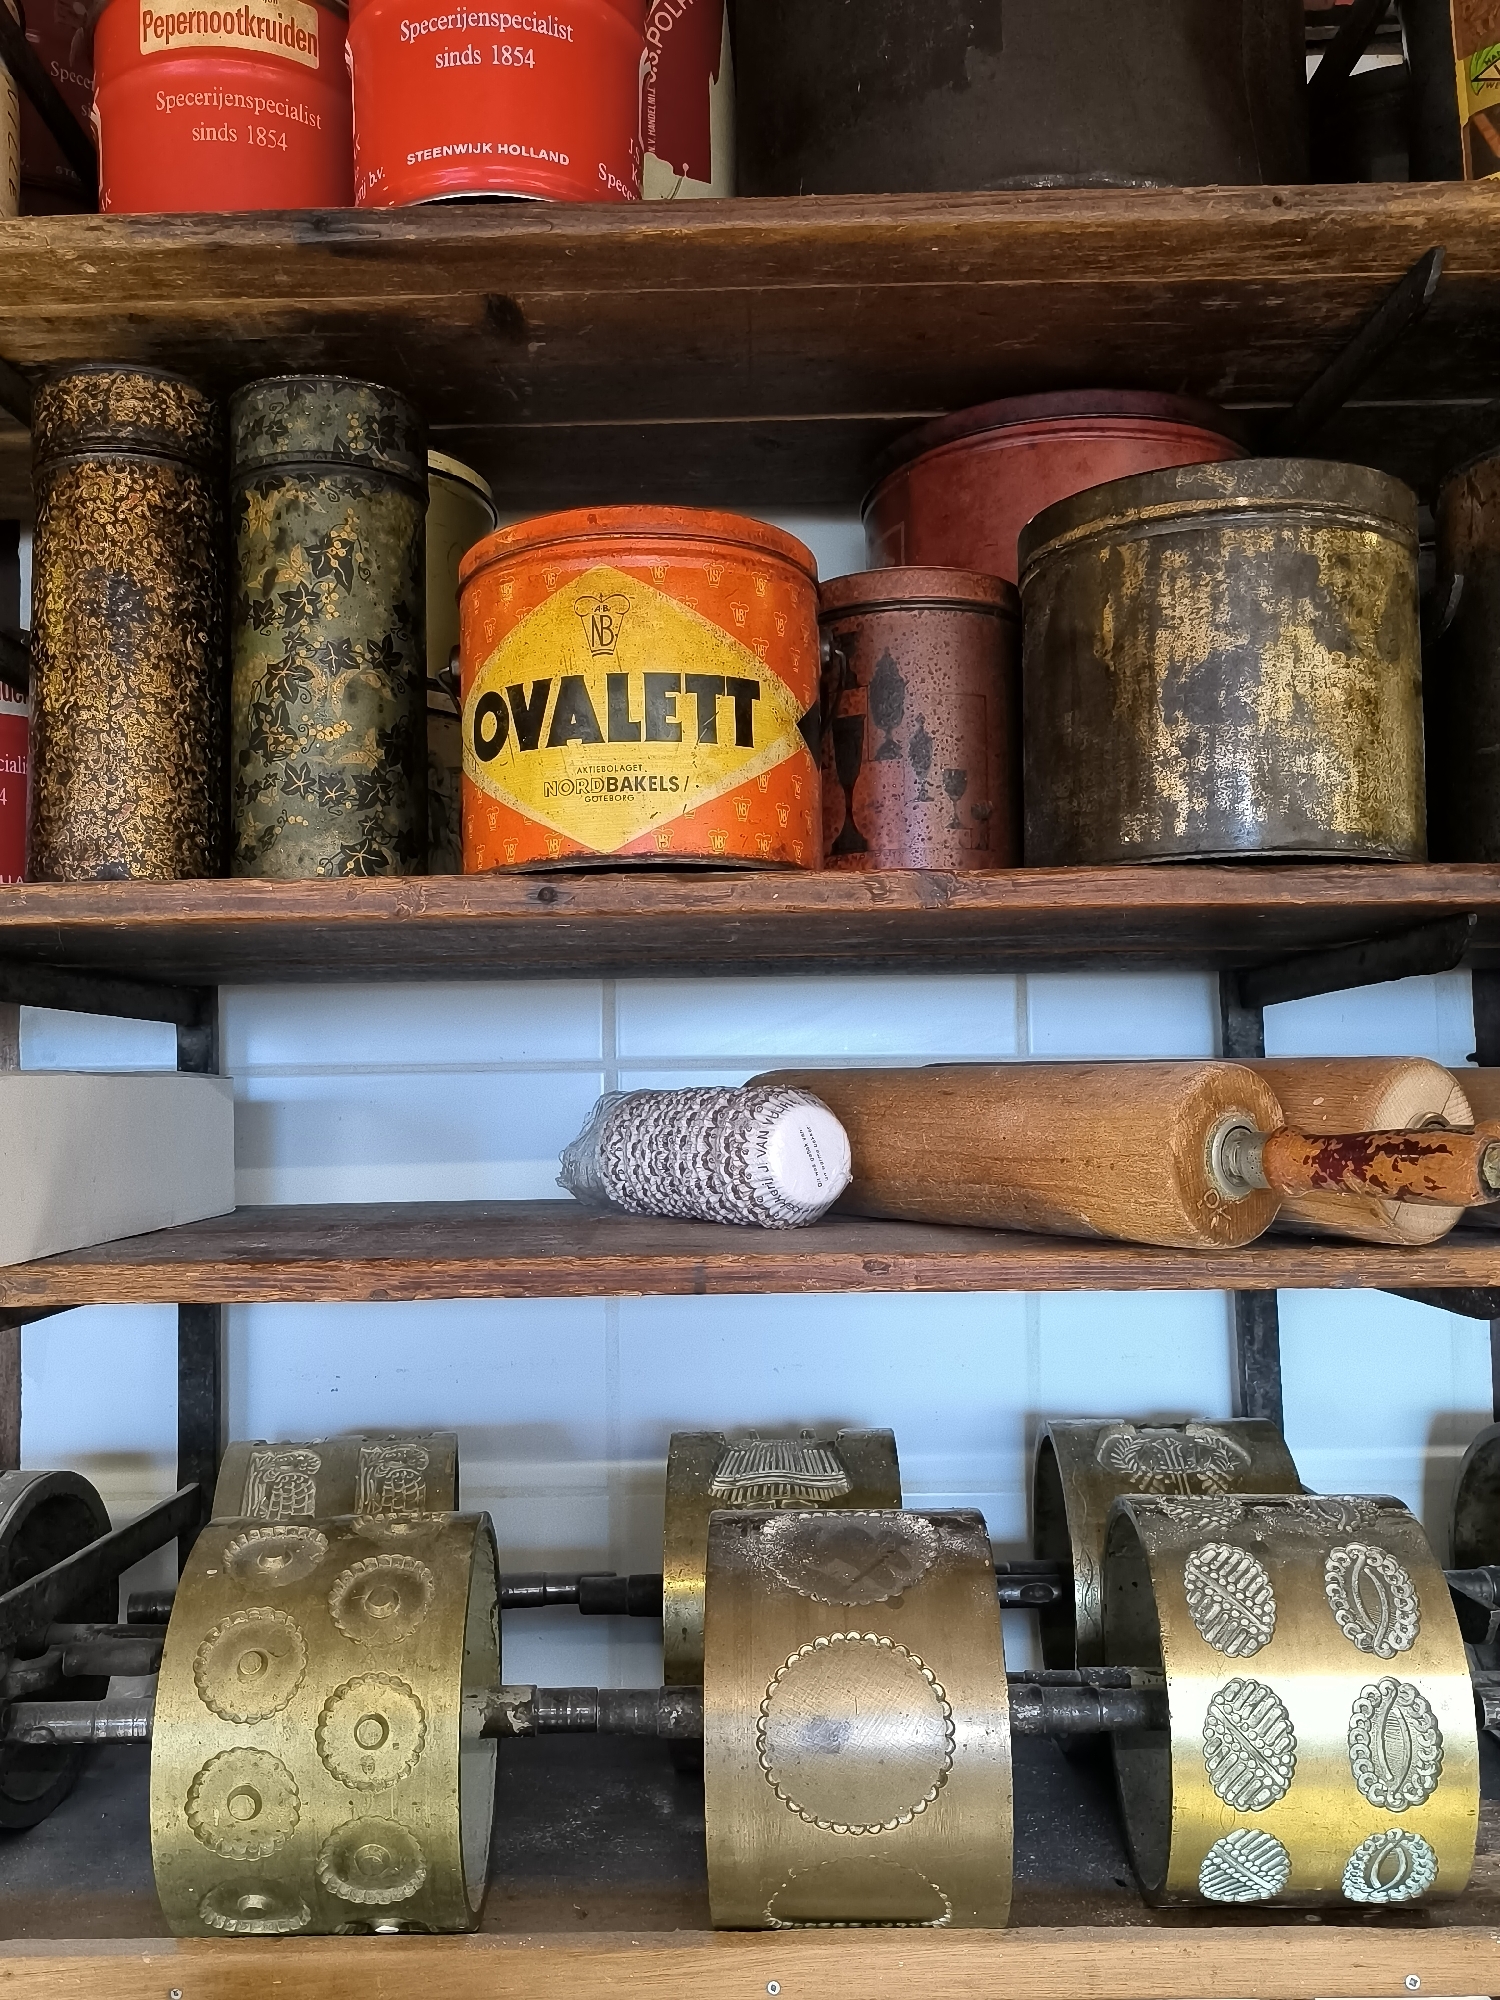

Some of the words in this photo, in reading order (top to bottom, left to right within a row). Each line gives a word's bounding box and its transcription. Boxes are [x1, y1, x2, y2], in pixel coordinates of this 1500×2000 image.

[142, 4, 318, 58] Pepernootkruiden
[400, 6, 574, 44] Specerijenspecialist
[434, 44, 482, 69] sinds
[491, 44, 536, 69] 1854
[156, 86, 322, 130] Specerijenspecialist
[191, 121, 238, 143] sinds
[246, 124, 288, 152] 1854
[406, 142, 493, 166] STEENWIJK
[497, 143, 570, 166] HOLLAND
[473, 671, 761, 763] OVALETT
[576, 763, 643, 775] AKTIEBOLAGET
[756, 1130, 770, 1158] VAN
